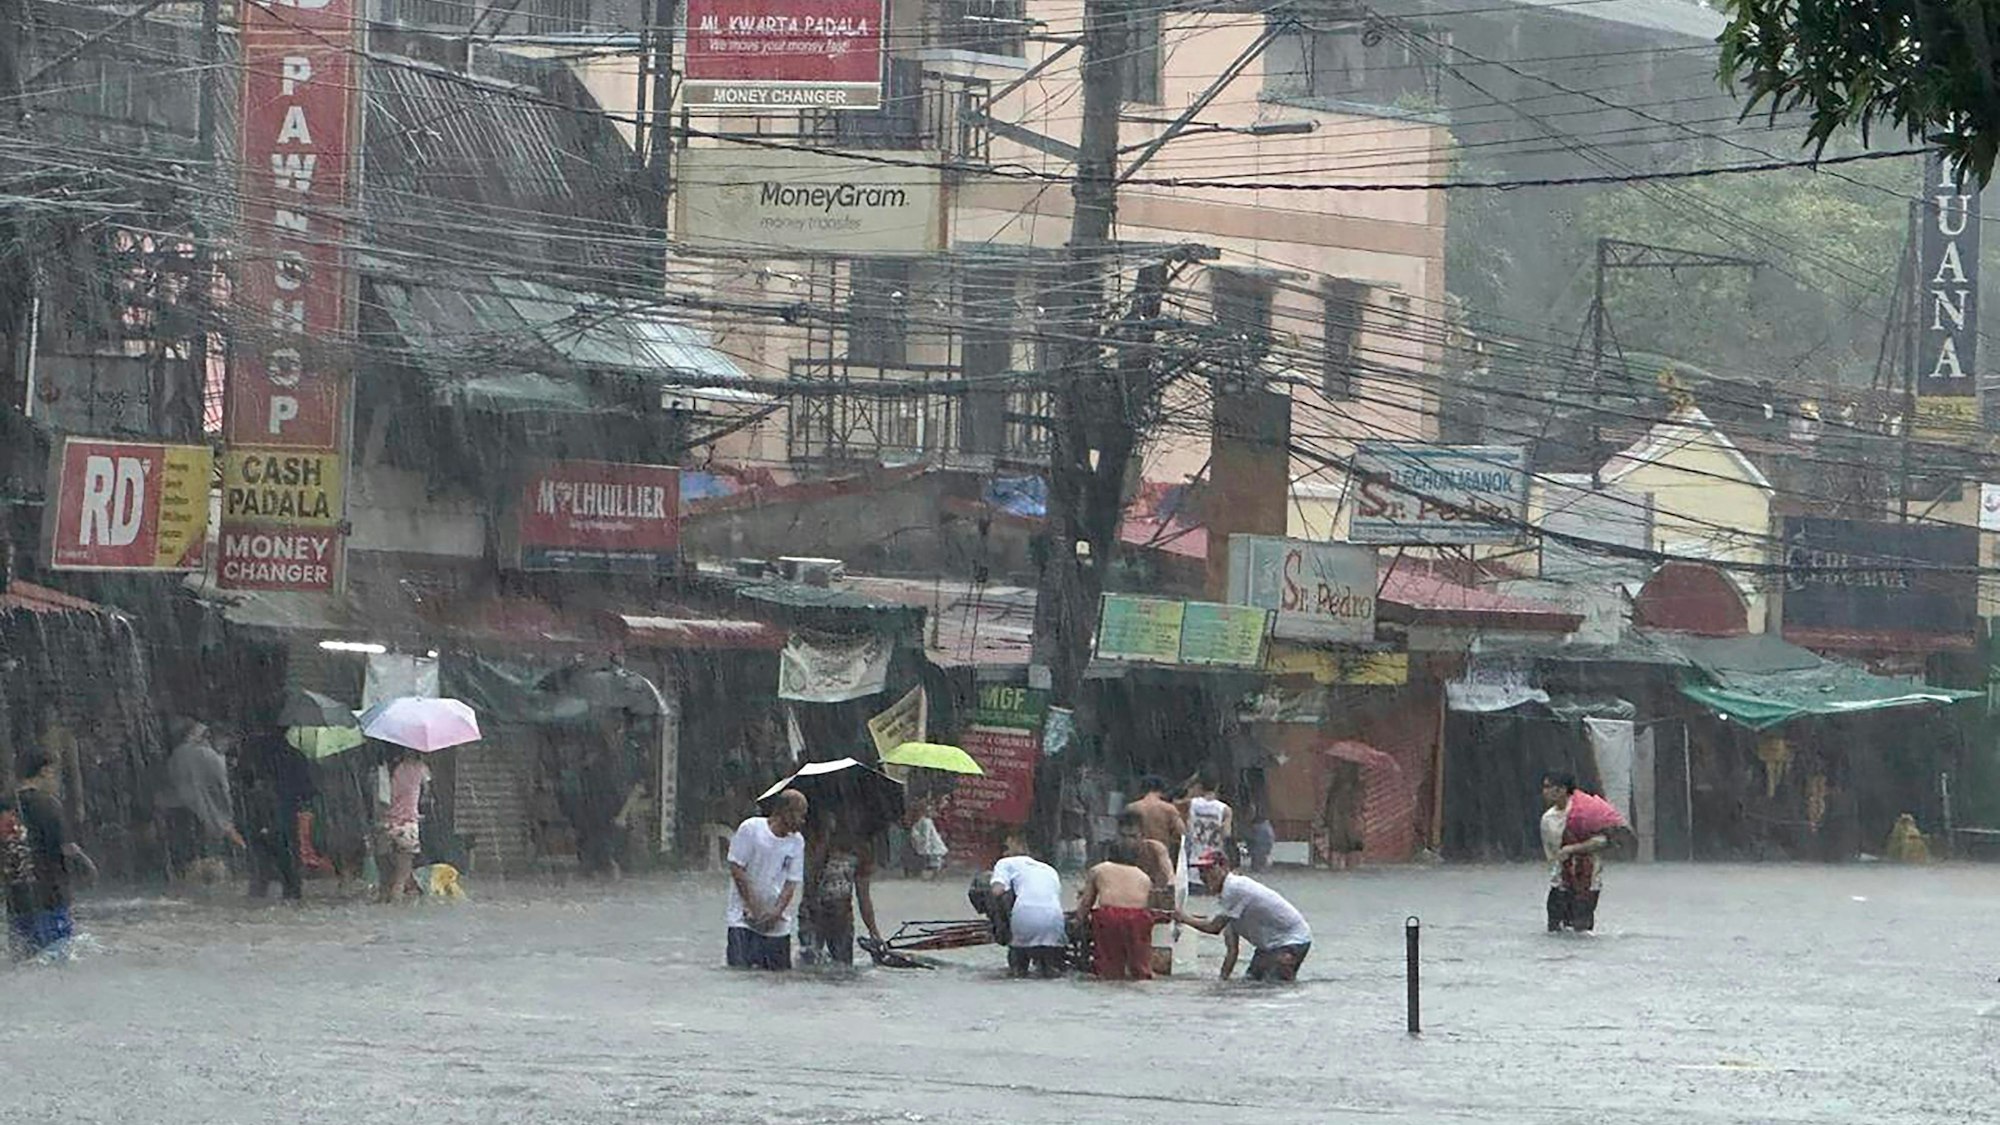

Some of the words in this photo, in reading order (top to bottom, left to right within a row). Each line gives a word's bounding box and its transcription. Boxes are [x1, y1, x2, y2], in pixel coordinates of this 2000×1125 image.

[729, 15, 798, 36] KWARTA
[804, 15, 869, 36] PADALA
[713, 88, 768, 103] MONEY
[771, 90, 847, 105] CHANGER
[242, 456, 322, 486] CASH
[80, 456, 145, 546] RD
[228, 488, 330, 518] PADALA
[225, 534, 329, 560] MONEY
[224, 561, 328, 583] CHANGER
[1316, 583, 1372, 619] Pedro
